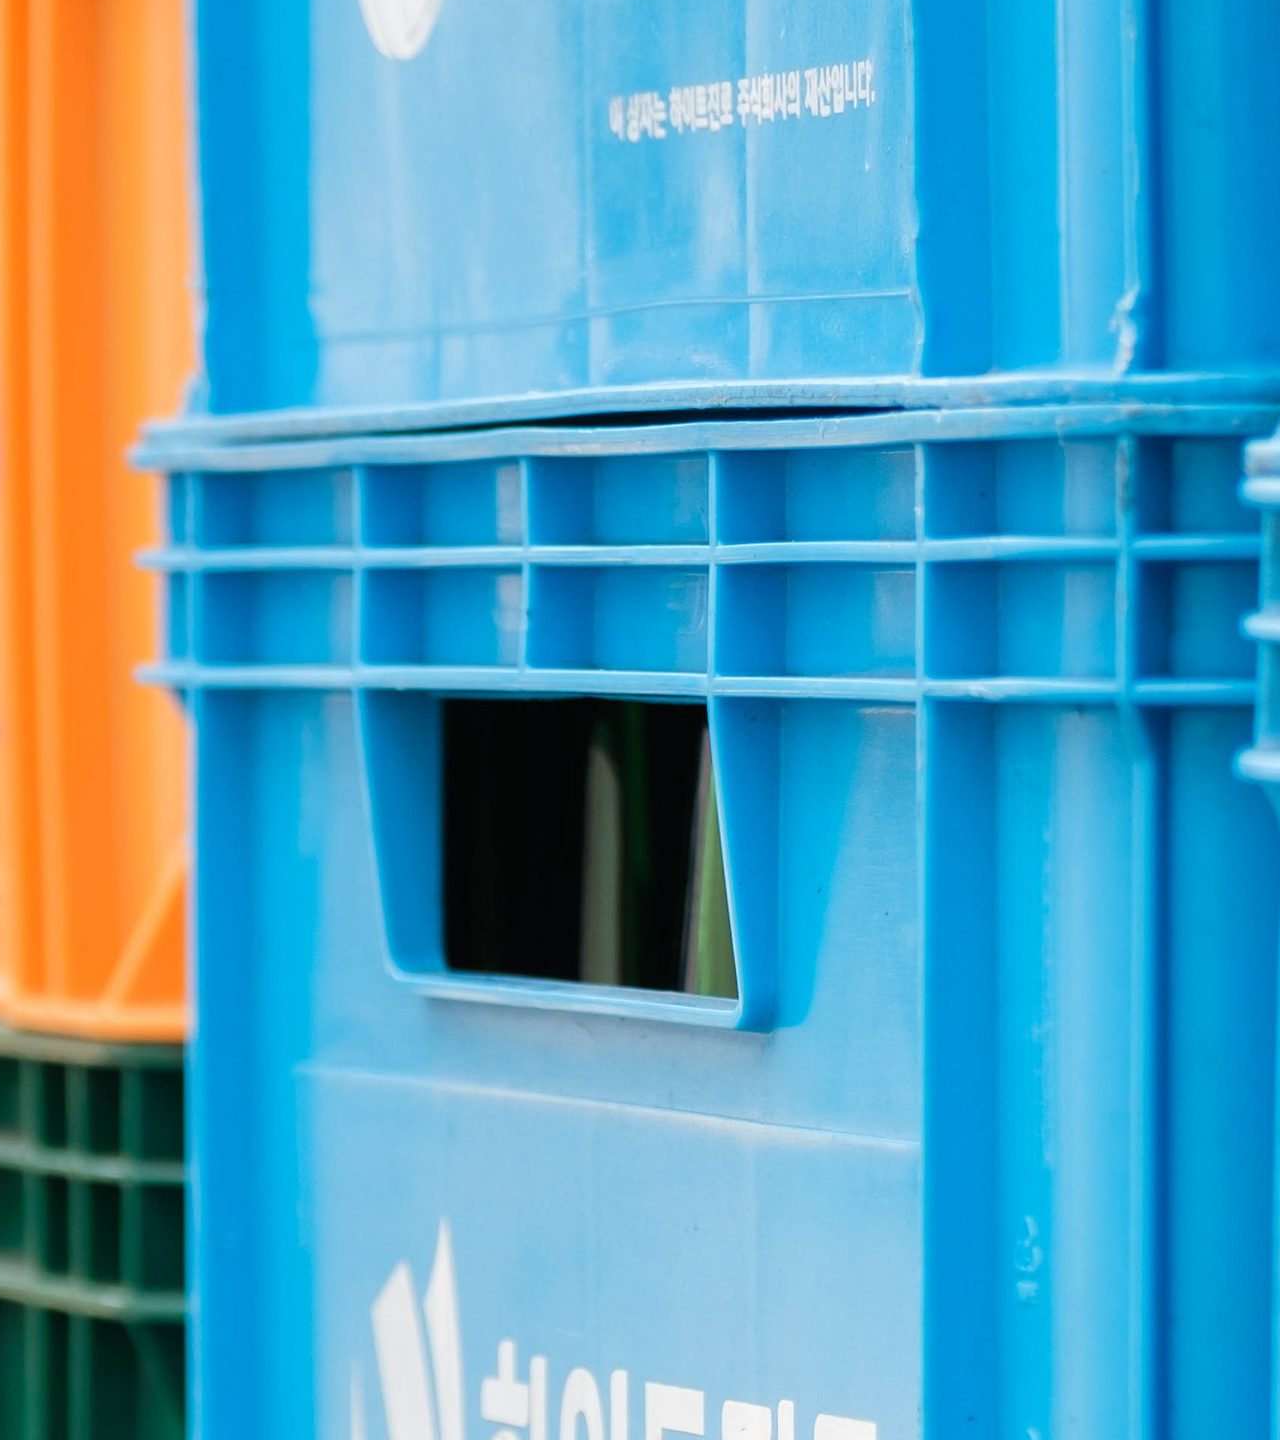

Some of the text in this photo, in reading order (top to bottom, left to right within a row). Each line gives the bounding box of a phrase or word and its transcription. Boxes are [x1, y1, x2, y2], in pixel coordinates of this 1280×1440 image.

[626, 91, 667, 143] 상자는
[669, 80, 733, 133] 하이트진로
[737, 69, 800, 127] 주식회사의
